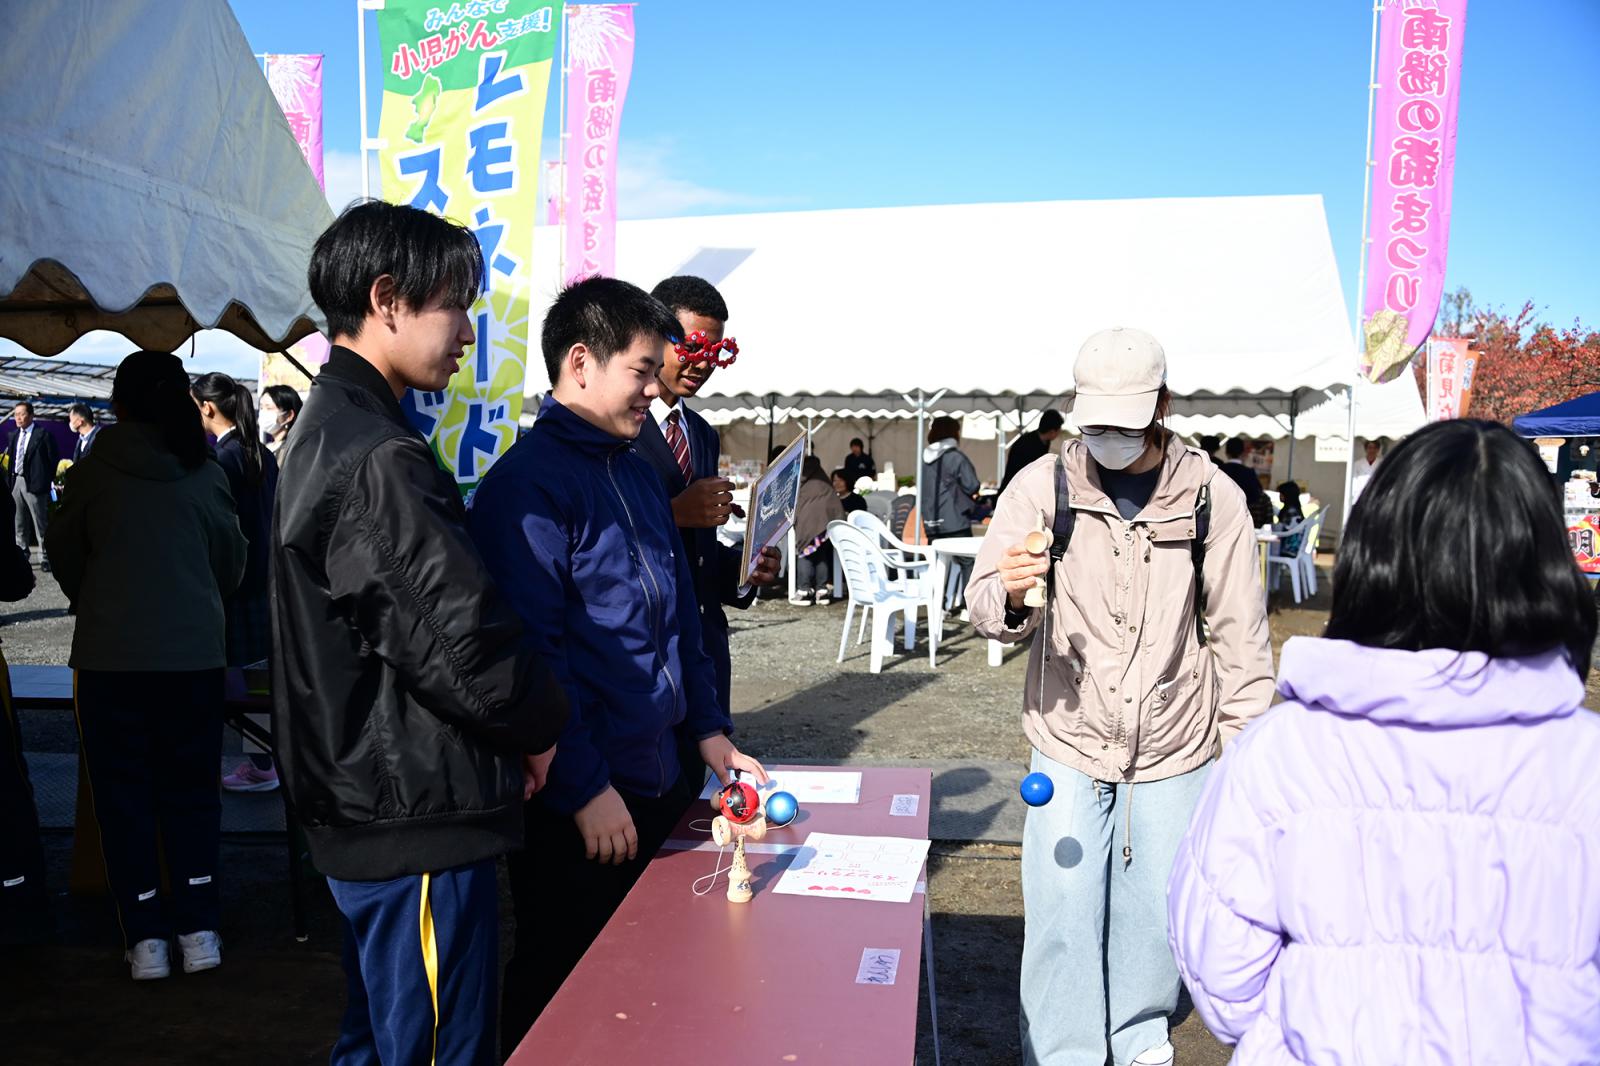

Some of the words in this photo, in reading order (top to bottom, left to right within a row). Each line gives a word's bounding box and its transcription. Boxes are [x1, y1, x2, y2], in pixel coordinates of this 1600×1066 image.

[425, 0, 506, 30] みんなで
[458, 56, 524, 477] レモネード
